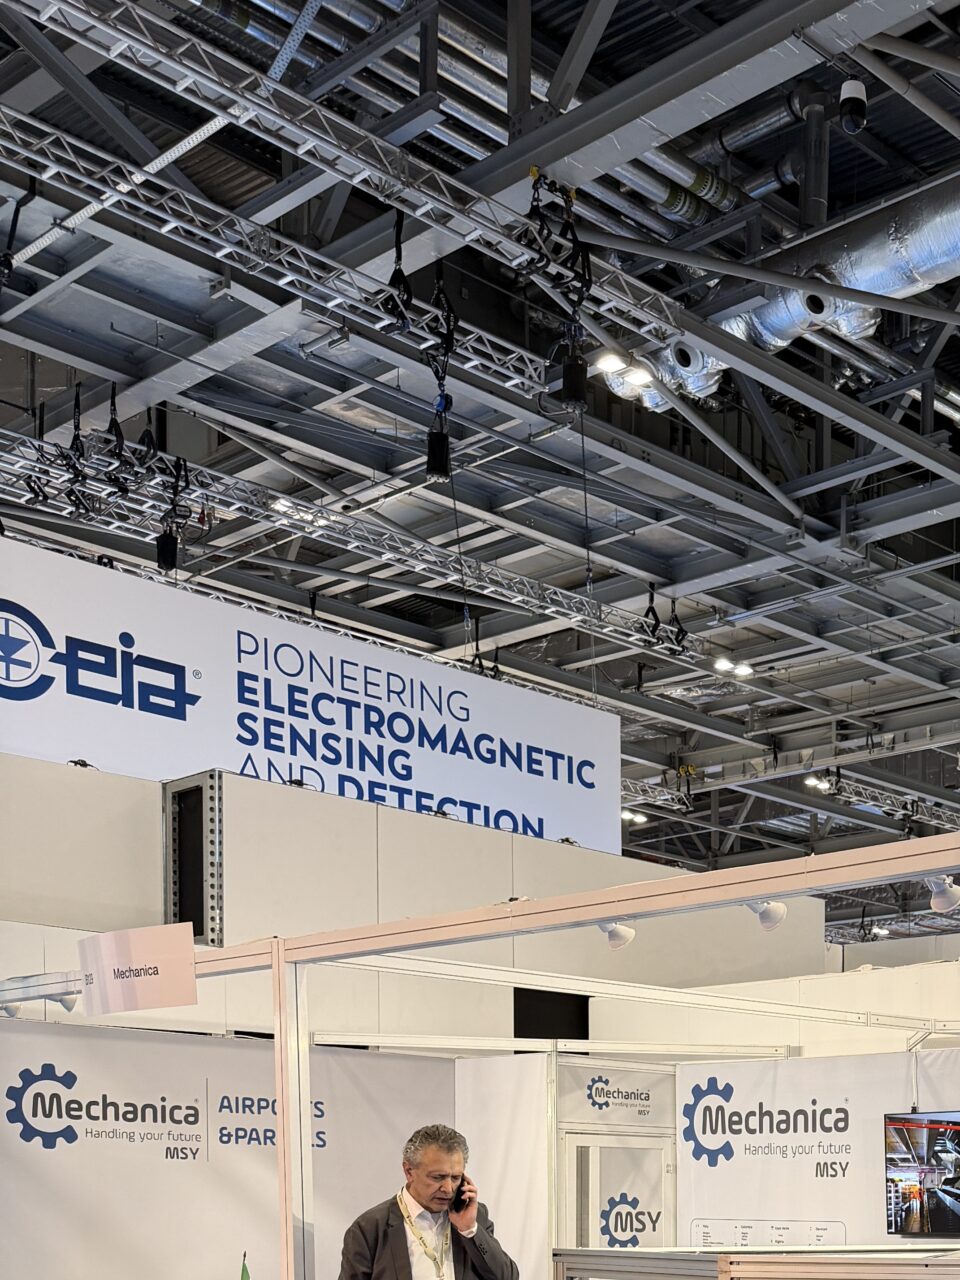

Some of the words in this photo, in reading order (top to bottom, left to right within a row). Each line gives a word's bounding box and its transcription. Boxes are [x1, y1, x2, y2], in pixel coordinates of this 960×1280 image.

[236, 629, 471, 722] PIONEERING
[236, 671, 596, 789] ELECTROMAGNETIC
[236, 712, 413, 782] SENSING
[239, 753, 325, 792] AND
[113, 964, 159, 980] Mechanica
[594, 1086, 650, 1102] Mechanica
[31, 1091, 200, 1126] Mechanica
[702, 1098, 849, 1136] Mechanica
[85, 1128, 135, 1142] Handling
[139, 1132, 164, 1142] your
[167, 1130, 202, 1142] future
[165, 1147, 200, 1160] MSY
[744, 1143, 788, 1158] Handling
[791, 1144, 814, 1159] your
[818, 1141, 851, 1155] future
[815, 1161, 849, 1178] MSY
[614, 1210, 662, 1233] MSY
